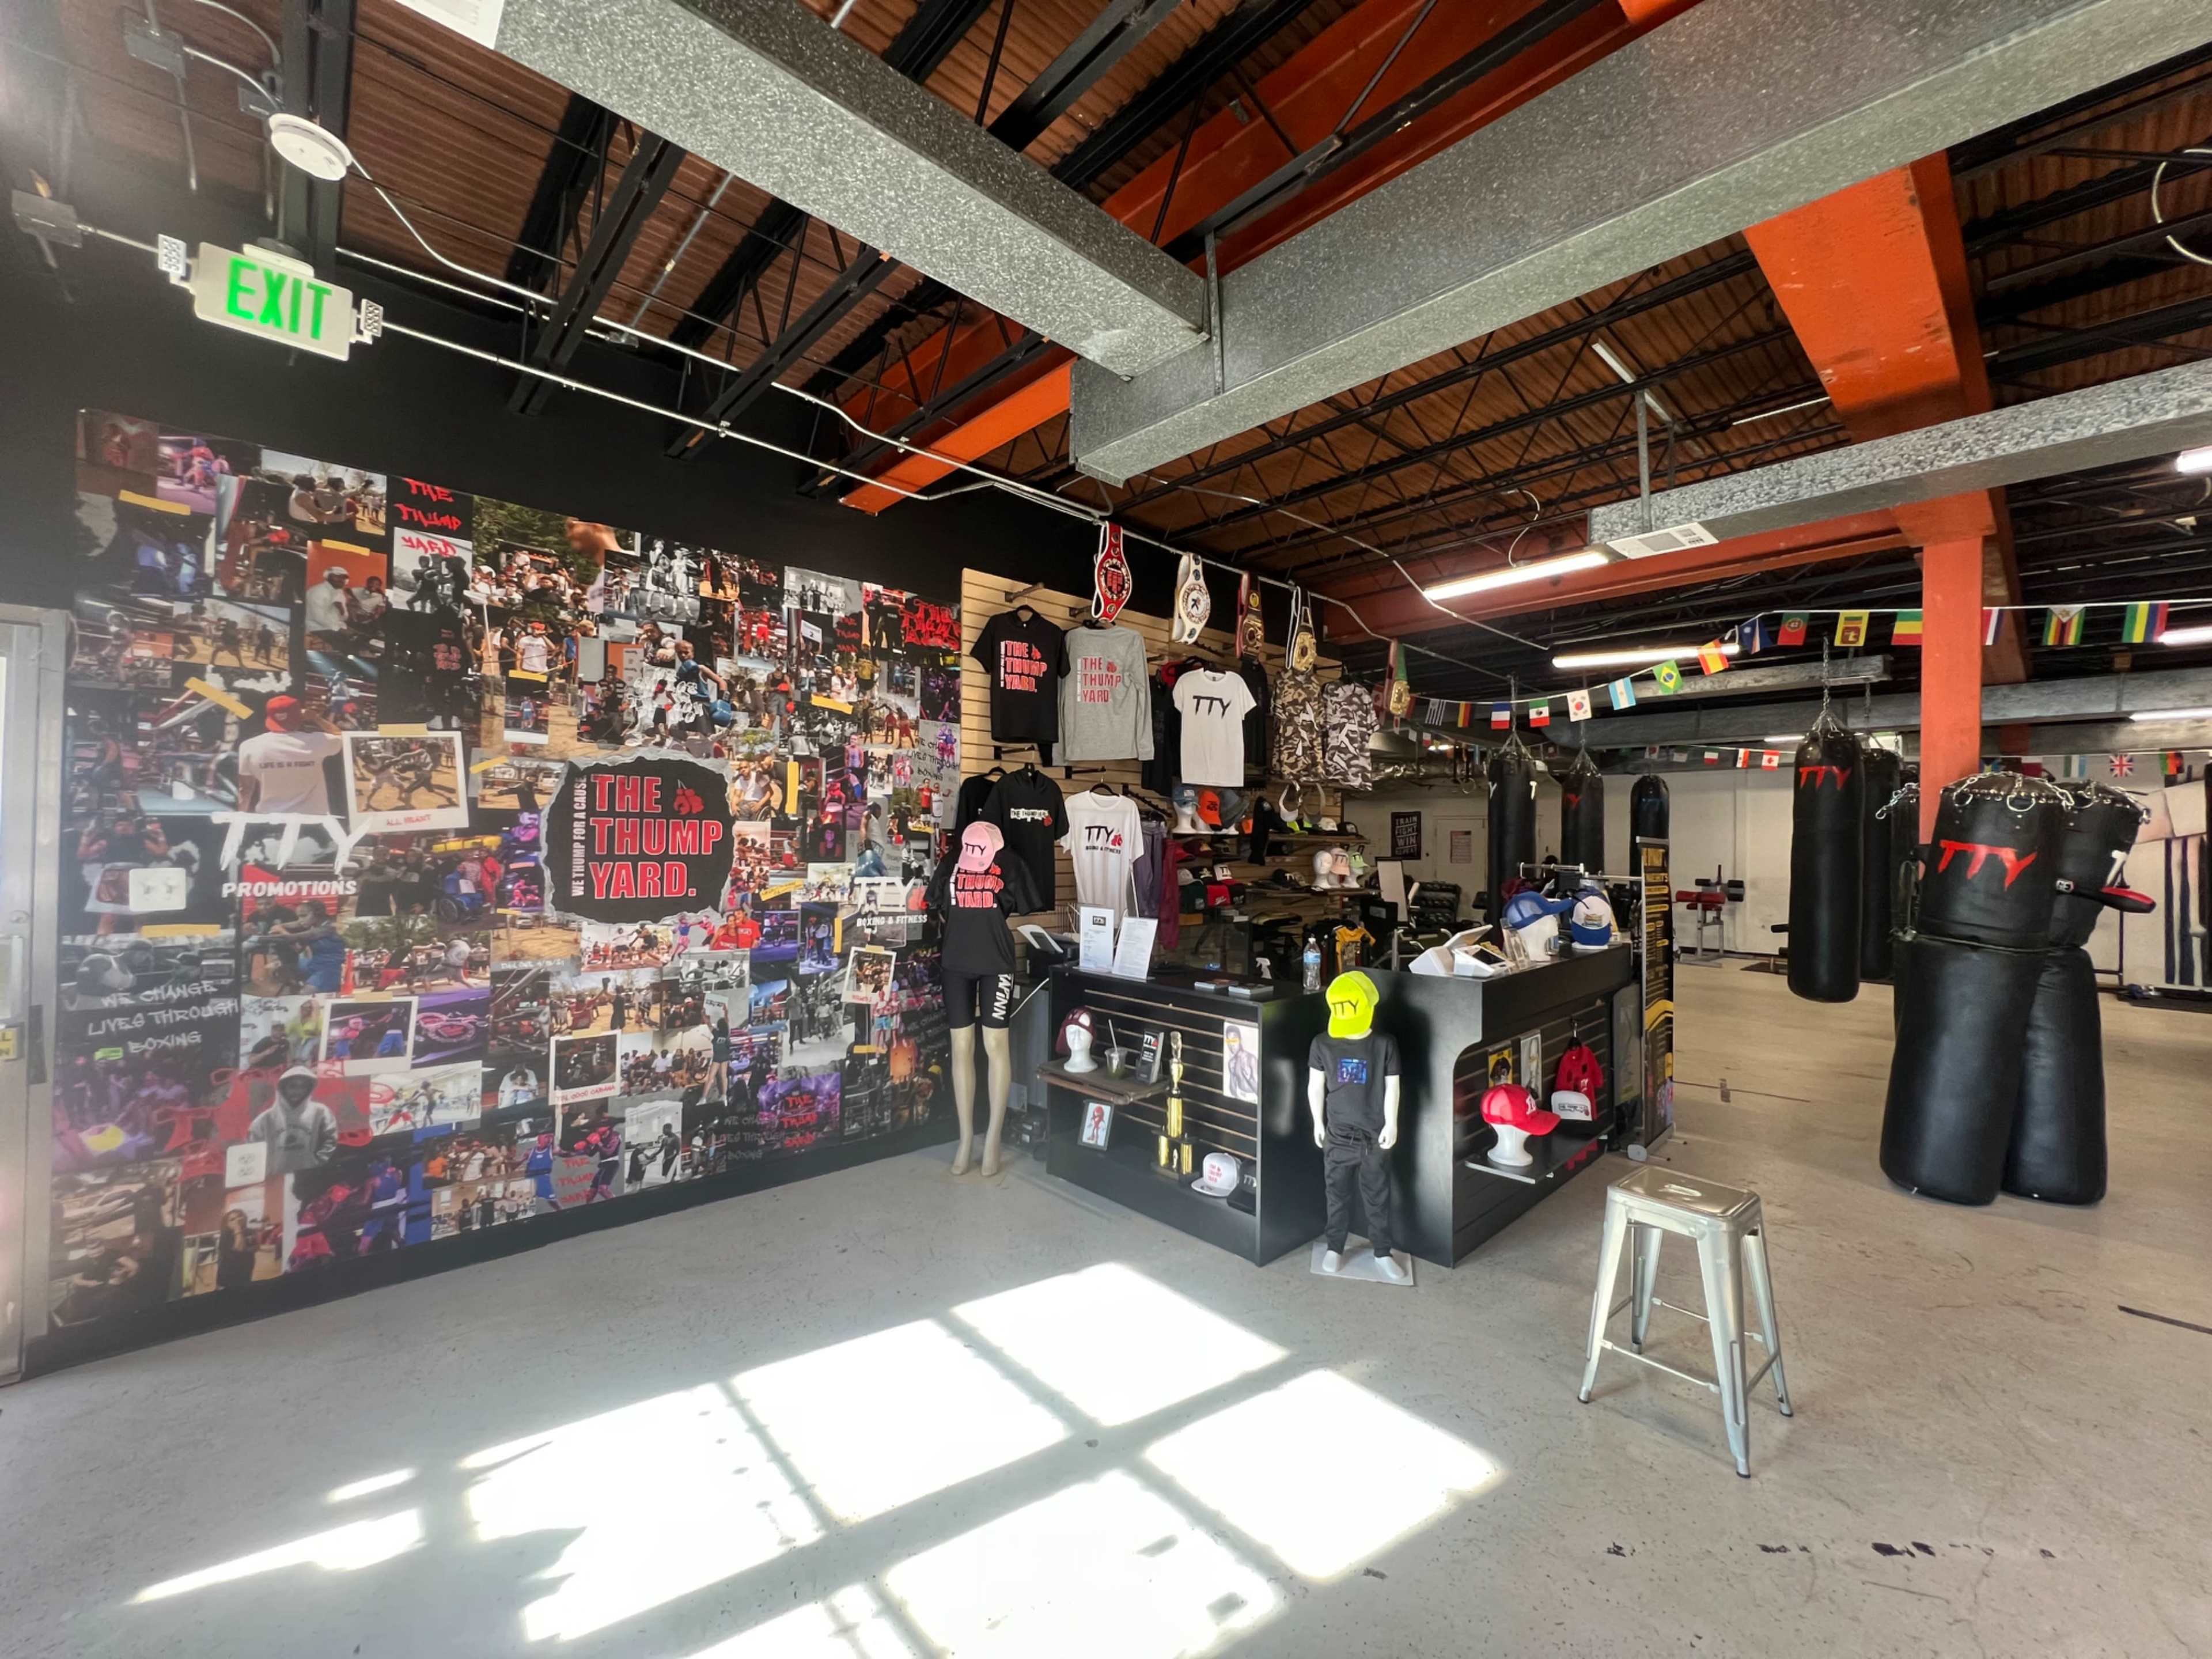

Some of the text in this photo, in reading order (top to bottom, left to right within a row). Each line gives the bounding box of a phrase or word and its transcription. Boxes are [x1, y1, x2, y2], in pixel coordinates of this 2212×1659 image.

[227, 257, 332, 340] EXIT
[402, 478, 454, 502] THE
[393, 503, 462, 531] THUMP
[402, 536, 457, 558] YARD
[1005, 641, 1029, 658] THE
[1005, 657, 1048, 677] THUMP
[1082, 657, 1103, 671] THE
[1082, 673, 1122, 688] THUMP
[1082, 690, 1109, 702] YARD
[1192, 695, 1232, 719] TTY
[1799, 765, 1853, 790] TTY
[573, 775, 587, 809] CAUSE
[590, 774, 662, 813] THE
[573, 820, 586, 840] FOR
[1395, 824, 1417, 836] FIGHT
[1396, 816, 1417, 825] TRAIN
[210, 811, 372, 876] TTY
[590, 817, 723, 855] THUMP
[1085, 825, 1113, 843] TTY
[1397, 835, 1416, 847] WIN
[572, 842, 586, 876] THUMP
[964, 842, 986, 856] TTY
[1937, 839, 2038, 892] TTY
[221, 880, 357, 899] PROMOTIONS
[571, 879, 585, 897] WE
[588, 861, 697, 899] YARD.
[957, 874, 1005, 893] THUMP
[854, 876, 915, 911] TTY
[956, 891, 998, 908] YARD.
[857, 916, 885, 927] BOXING
[896, 914, 928, 924] FITNESS
[101, 980, 218, 1007] WE CHANGE
[88, 998, 239, 1036] LIVES THROUGH
[1331, 998, 1359, 1016] TTY
[127, 1031, 202, 1054] BOXING
